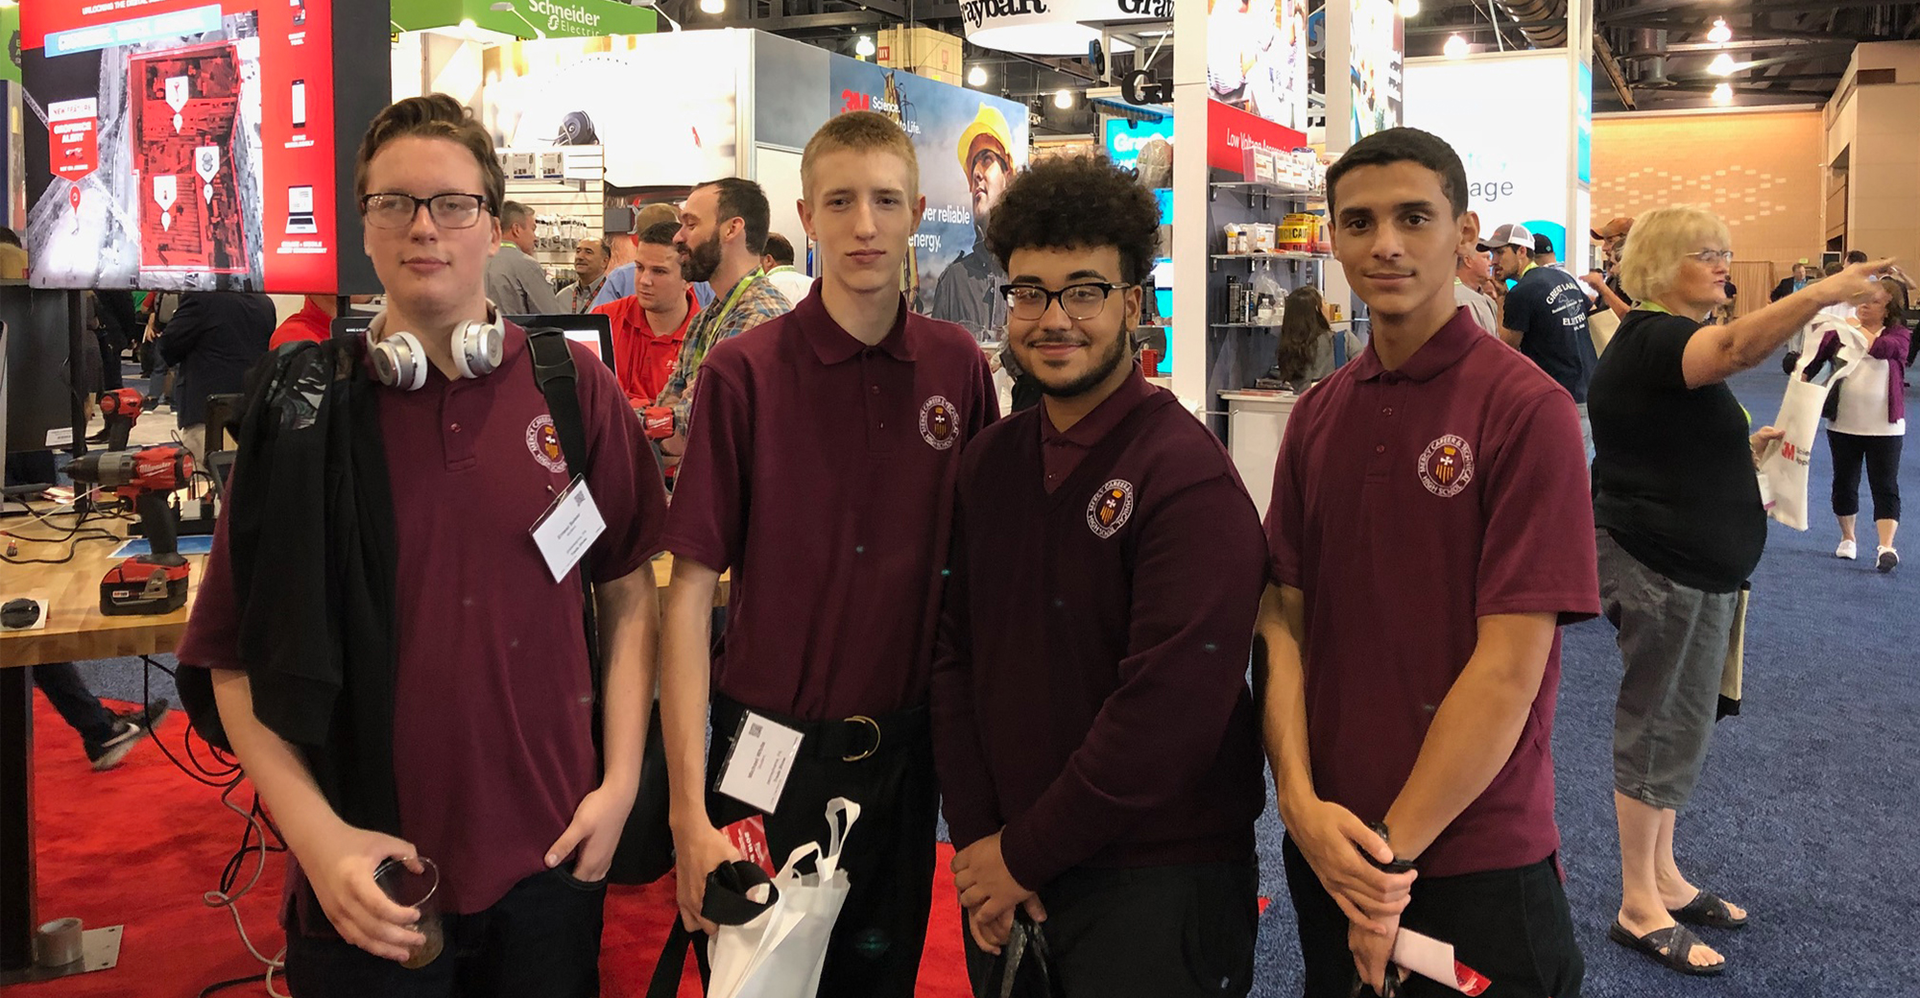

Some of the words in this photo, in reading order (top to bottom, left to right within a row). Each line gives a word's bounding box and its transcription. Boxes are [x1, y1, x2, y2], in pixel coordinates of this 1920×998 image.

[529, 0, 600, 26] Schneider
[841, 89, 870, 113] 3M
[1226, 127, 1240, 149] Low
[1469, 181, 1514, 202] age
[938, 204, 970, 225] reliable
[907, 233, 942, 253] energy.
[1418, 448, 1432, 473] MERCY
[1781, 440, 1796, 461] 3M
